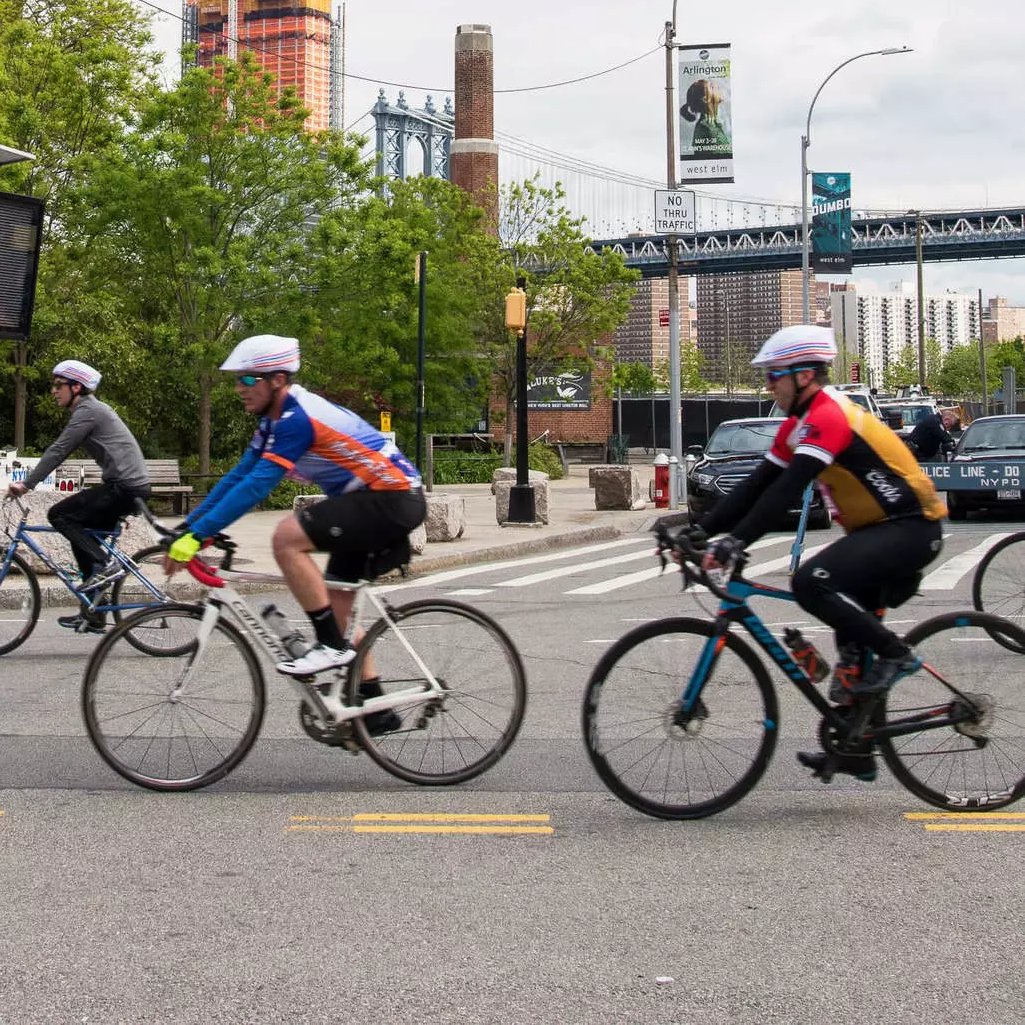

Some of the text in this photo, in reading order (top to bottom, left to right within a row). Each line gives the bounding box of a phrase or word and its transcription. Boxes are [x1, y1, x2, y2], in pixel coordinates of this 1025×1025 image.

[683, 65, 727, 76] Arlington
[687, 164, 728, 174] west elm
[667, 196, 682, 206] NO
[812, 197, 851, 216] DUMBO
[663, 209, 687, 218] THRU
[658, 220, 694, 230] TRAFFIC
[919, 466, 951, 478] OLICE
[960, 466, 986, 477] LINE
[1004, 465, 1020, 477] DO
[980, 478, 1020, 487] NYPD
